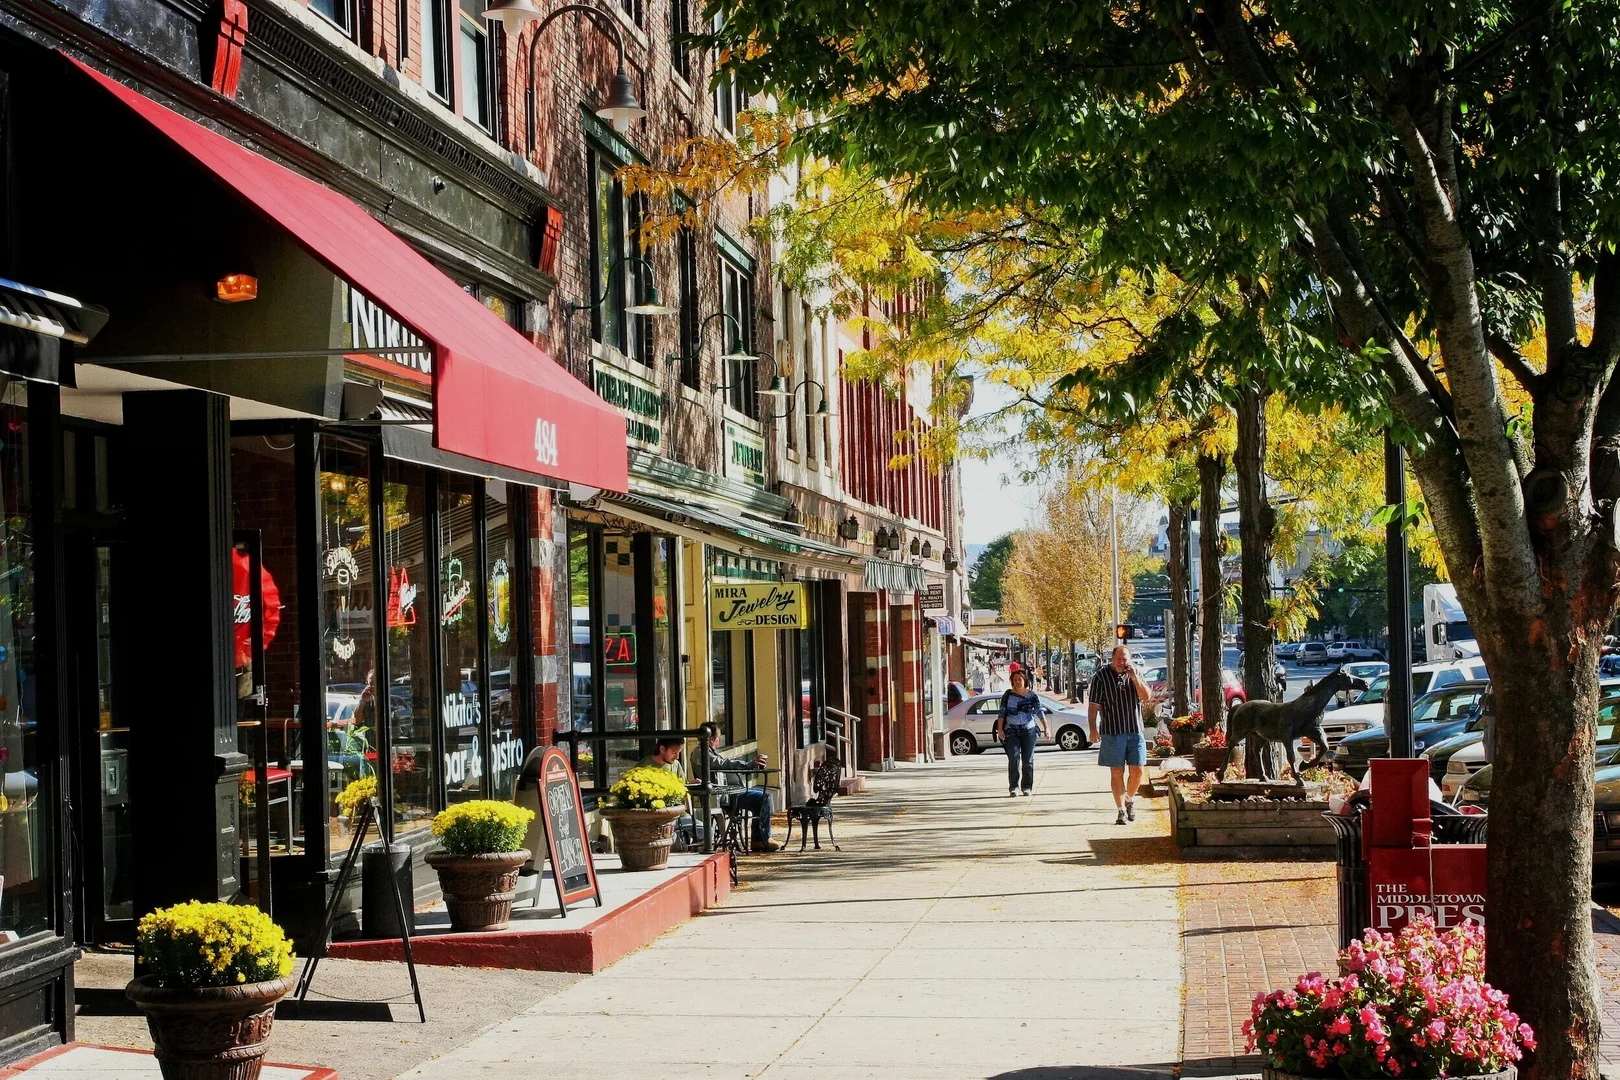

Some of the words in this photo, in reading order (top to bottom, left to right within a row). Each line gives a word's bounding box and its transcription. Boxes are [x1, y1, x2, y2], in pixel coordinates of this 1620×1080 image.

[534, 417, 558, 467] 484
[715, 588, 747, 598] MIRA
[719, 587, 795, 622] Jewelry
[755, 614, 797, 625] DESIGN
[547, 782, 573, 817] OPEN
[1375, 884, 1407, 893] THE
